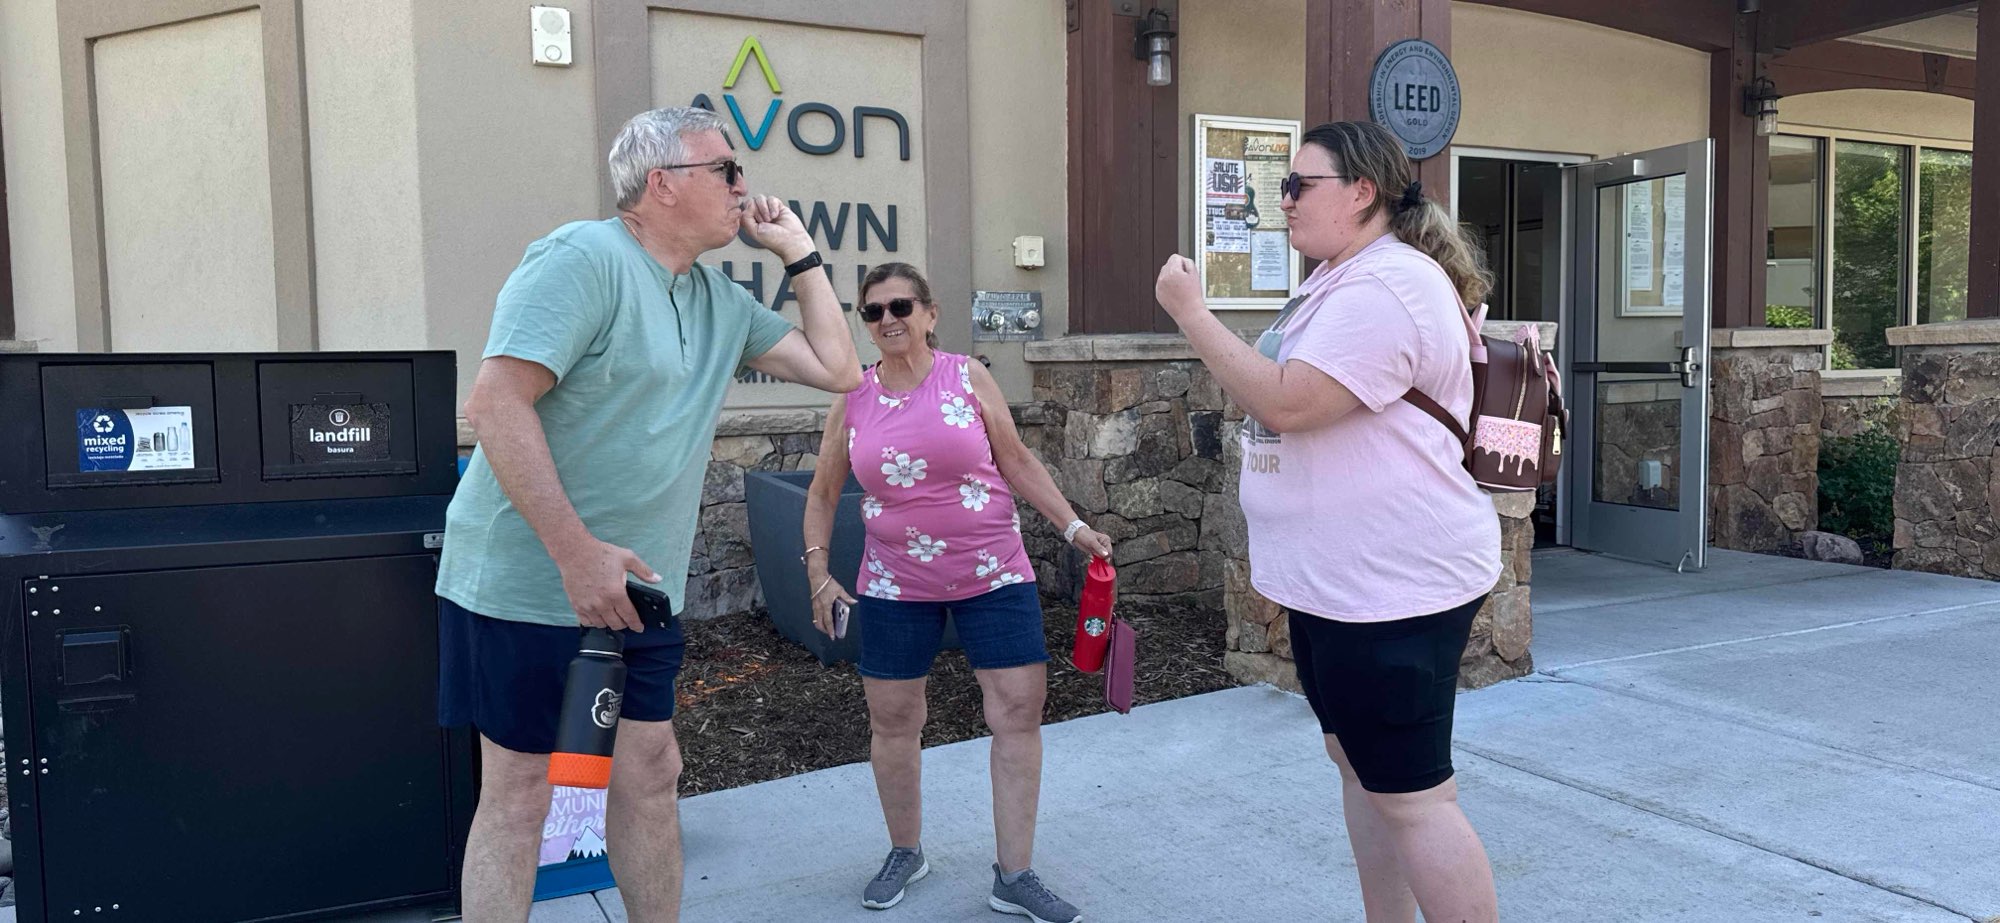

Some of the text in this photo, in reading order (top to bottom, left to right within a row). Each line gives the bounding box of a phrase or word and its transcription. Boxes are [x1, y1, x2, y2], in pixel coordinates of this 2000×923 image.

[1384, 46, 1408, 70] ENERGY
[1409, 45, 1423, 53] AND
[1424, 47, 1457, 108] ENVIRONMENTAL
[1441, 111, 1457, 140] DESIGN
[1394, 82, 1441, 113] LEED
[1406, 117, 1429, 127] GOLD
[1408, 146, 1427, 156] 2019
[1213, 161, 1239, 174] SALUTE
[1212, 173, 1240, 194] USA
[84, 434, 126, 446] mixed
[309, 427, 371, 442] landfill
[86, 445, 124, 454] recycling
